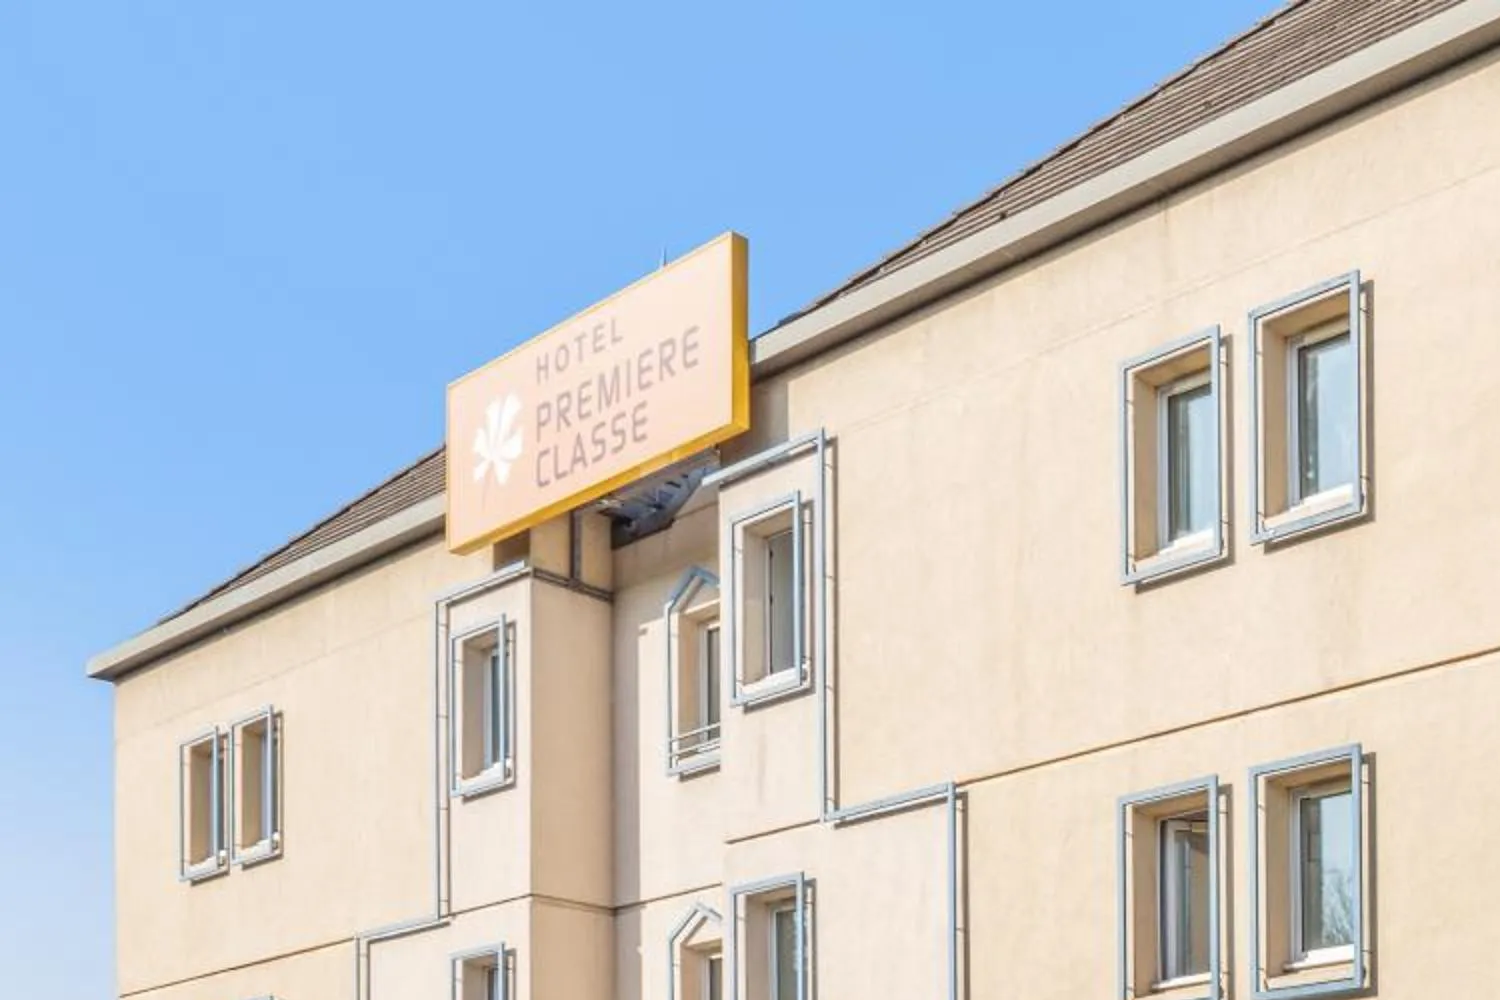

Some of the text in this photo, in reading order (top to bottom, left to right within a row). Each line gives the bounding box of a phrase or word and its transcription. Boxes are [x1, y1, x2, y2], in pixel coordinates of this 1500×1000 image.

[536, 318, 623, 384] HOTEL
[536, 325, 700, 443] PREMIERE
[535, 401, 648, 487] CLASSE
